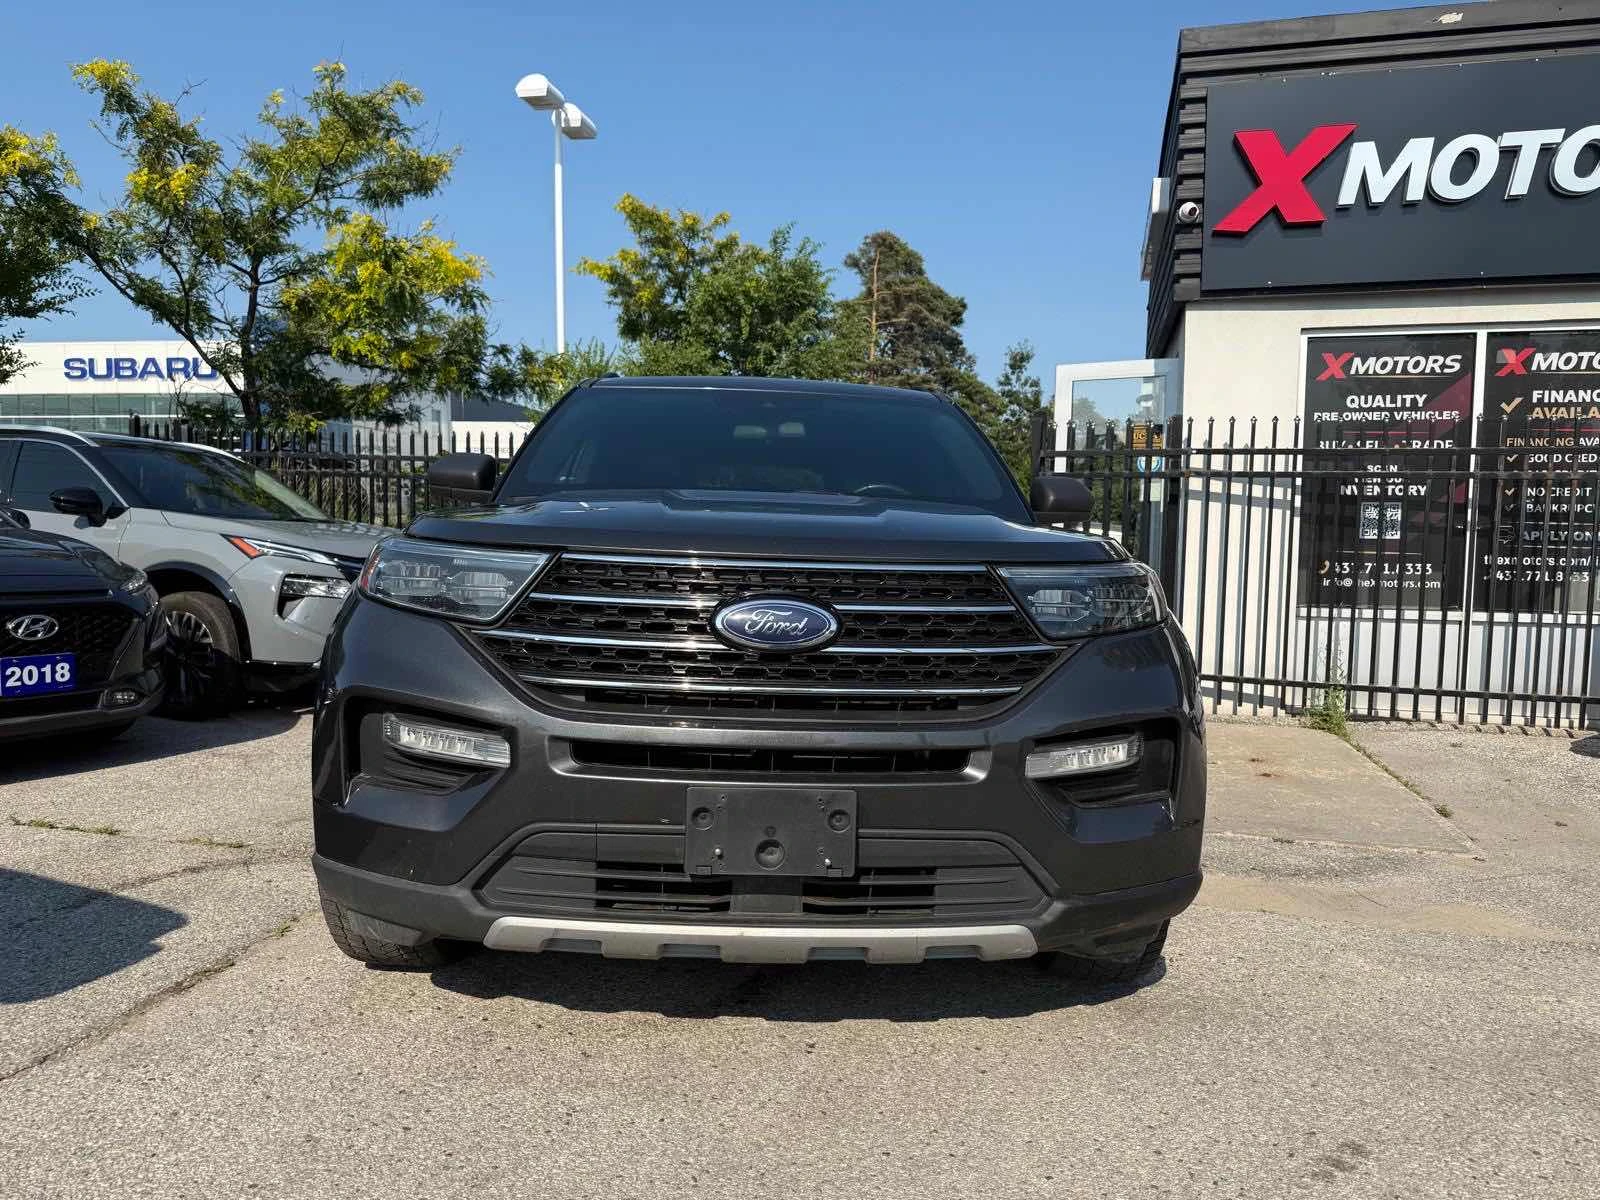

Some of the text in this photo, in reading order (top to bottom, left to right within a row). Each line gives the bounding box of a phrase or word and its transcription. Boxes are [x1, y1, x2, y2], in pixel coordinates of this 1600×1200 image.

[1212, 123, 1358, 235] X
[63, 356, 219, 381] SUBARU
[1315, 352, 1463, 381] X MOTORS
[1495, 347, 1537, 376] X
[1345, 393, 1428, 409] QUALITY
[1313, 410, 1461, 423] PREOWNED VEHICLES
[1506, 437, 1575, 448] FINANCNG
[1366, 464, 1398, 473] SCN
[1340, 484, 1428, 496] NVENTORY
[1527, 487, 1546, 497] NO
[744, 608, 809, 636] Ford
[5, 662, 71, 688] 2018
